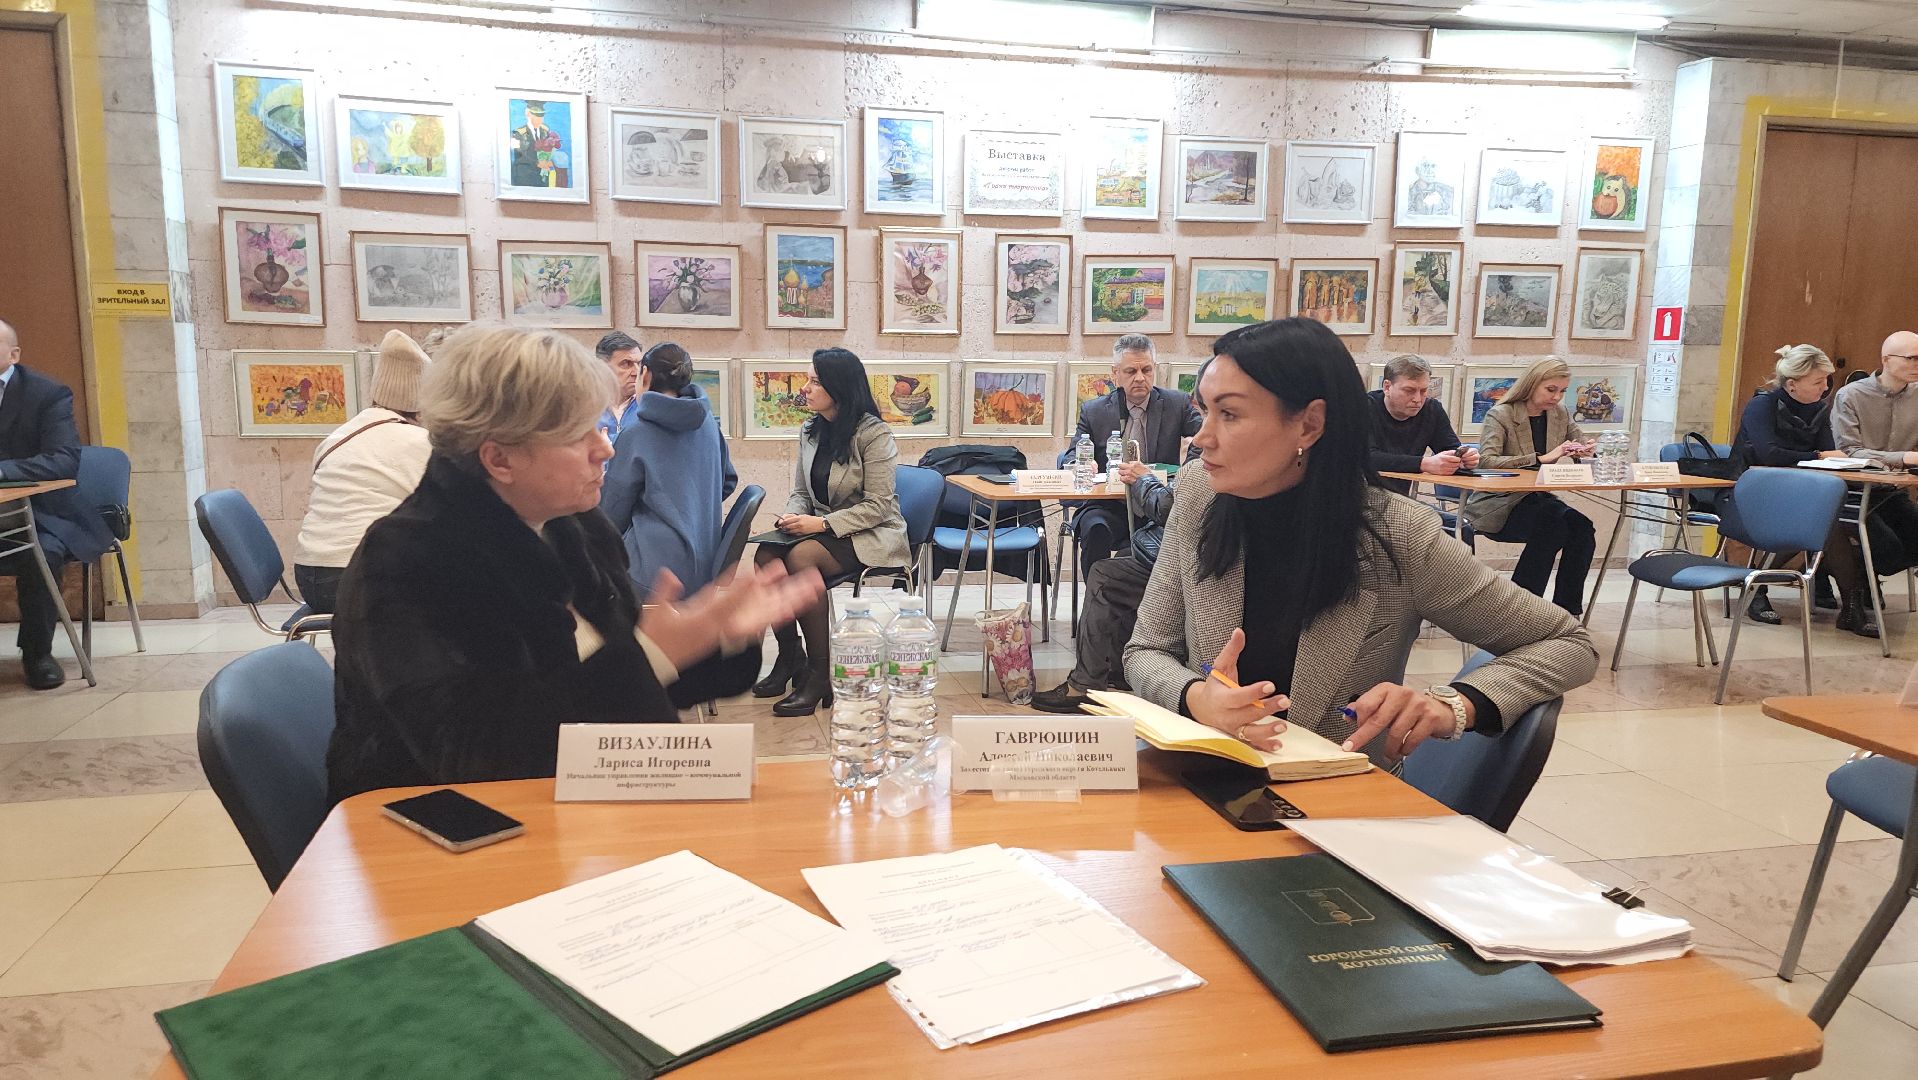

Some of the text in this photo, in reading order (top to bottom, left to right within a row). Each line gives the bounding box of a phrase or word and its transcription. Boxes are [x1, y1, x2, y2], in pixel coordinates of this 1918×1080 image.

[988, 148, 1046, 161] Выставка
[597, 736, 713, 750] ВИЗАУЛИНА
[995, 731, 1100, 744] ГАВРЮШИН
[594, 757, 711, 771] Лариса Игоревна
[1308, 942, 1455, 963] ГОРОДСКОЙ ОКРУГ
[1337, 953, 1448, 970] КОТЕЛЬНИКИ
